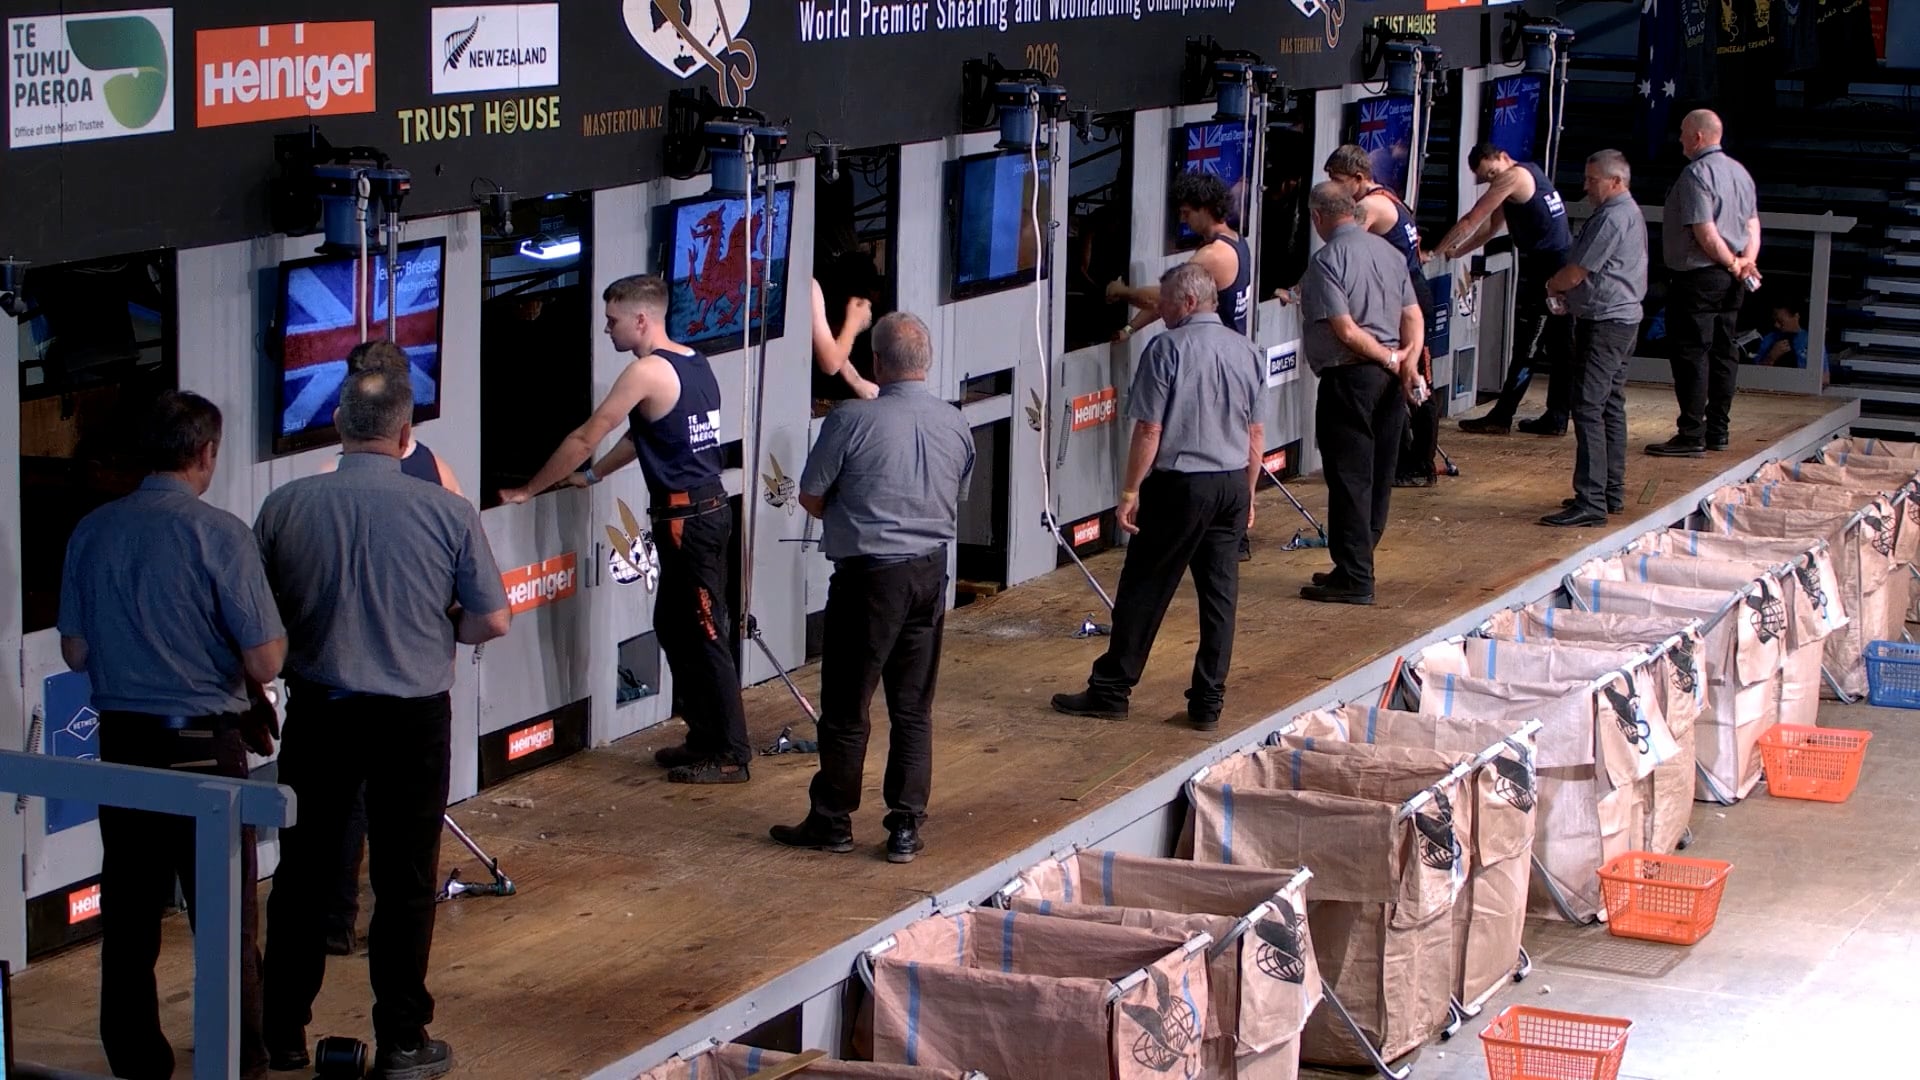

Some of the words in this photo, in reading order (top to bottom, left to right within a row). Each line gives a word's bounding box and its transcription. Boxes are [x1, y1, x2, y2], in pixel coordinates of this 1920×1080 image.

[13, 23, 36, 49] TE
[800, 1, 850, 42] World
[860, 0, 929, 36] Premier
[936, 0, 1009, 31] Shearing
[1015, 0, 1041, 23] and
[1374, 15, 1405, 34] TUST
[14, 50, 70, 78] TUMU
[204, 23, 372, 110] Heiniger
[469, 50, 495, 69] NEW
[496, 46, 547, 67] ZEALAND
[1026, 42, 1060, 79] 2026
[15, 77, 93, 108] PAEROA
[15, 124, 35, 138] Office
[36, 123, 44, 136] of
[45, 122, 56, 135] the
[78, 120, 104, 131] Trustee
[398, 103, 475, 144] TRUST
[485, 95, 560, 135] HOUSE
[583, 105, 664, 137] MASTERTON.NZ
[687, 414, 698, 425] TE
[1075, 391, 1117, 425] Heiniger
[688, 421, 711, 435] TUMU
[505, 560, 576, 606] Heiniger
[510, 725, 553, 754] Heiniger
